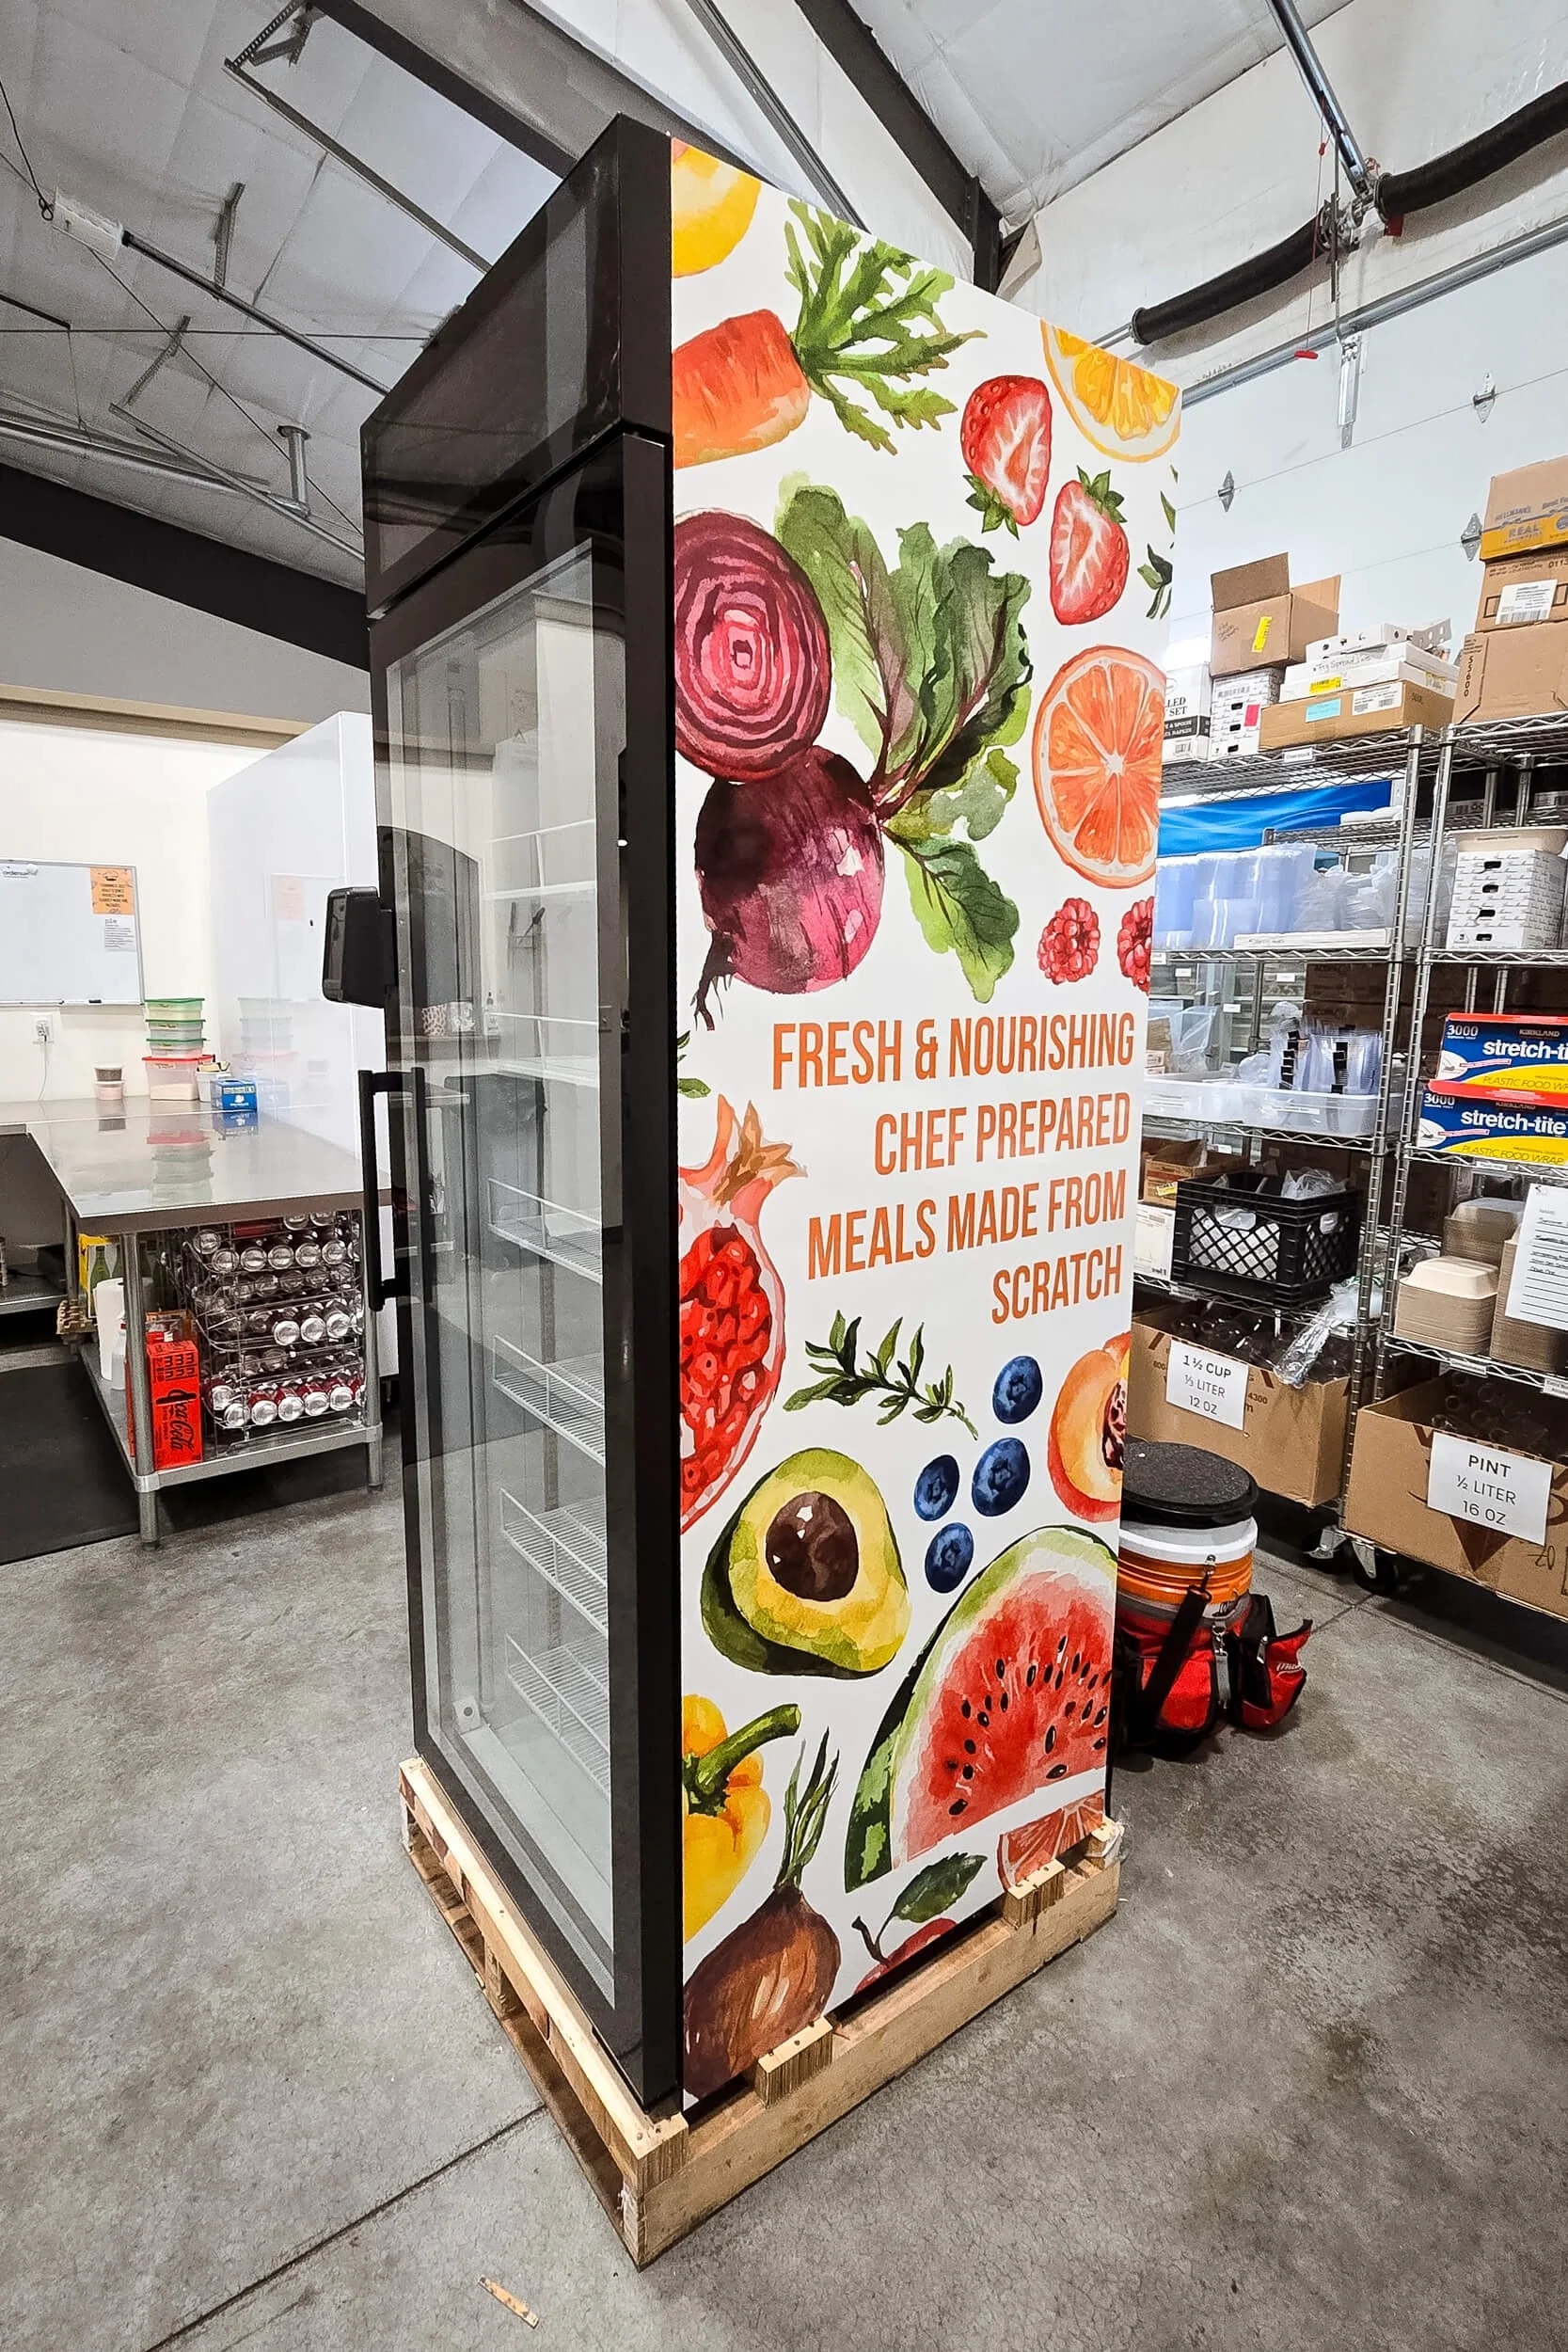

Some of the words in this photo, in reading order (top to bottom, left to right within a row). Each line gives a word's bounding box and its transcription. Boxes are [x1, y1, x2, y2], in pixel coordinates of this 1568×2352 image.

[1447, 1025, 1479, 1037] 3000
[773, 1020, 902, 1090] FRESH
[915, 1020, 938, 1081] &
[949, 1012, 1134, 1077] NOURISHING
[1482, 1076, 1521, 1088] PLASTIC
[1521, 1079, 1551, 1089] FOOD
[1424, 1093, 1455, 1106] 3000
[875, 1107, 966, 1175] CHEF
[976, 1092, 1130, 1162] PREPARED
[1461, 1109, 1566, 1135] stretch-tite
[1462, 1145, 1500, 1158] PLASTIC
[1500, 1150, 1529, 1161] FOOD
[1532, 1153, 1565, 1166] WRAP
[808, 1200, 936, 1279] MEALS
[947, 1183, 1039, 1252] MADE
[1048, 1169, 1127, 1232] FROM
[991, 1245, 1122, 1324] SCRATCH
[1183, 1356, 1190, 1366] 1
[1206, 1363, 1232, 1378] CUP
[1197, 1379, 1226, 1398] LITER
[1189, 1395, 1200, 1408] 12
[1203, 1401, 1218, 1415] OZ
[1468, 1454, 1512, 1478] PINT
[1474, 1481, 1517, 1505] LITER
[1463, 1501, 1480, 1517] 16
[1485, 1508, 1506, 1525] OZ
